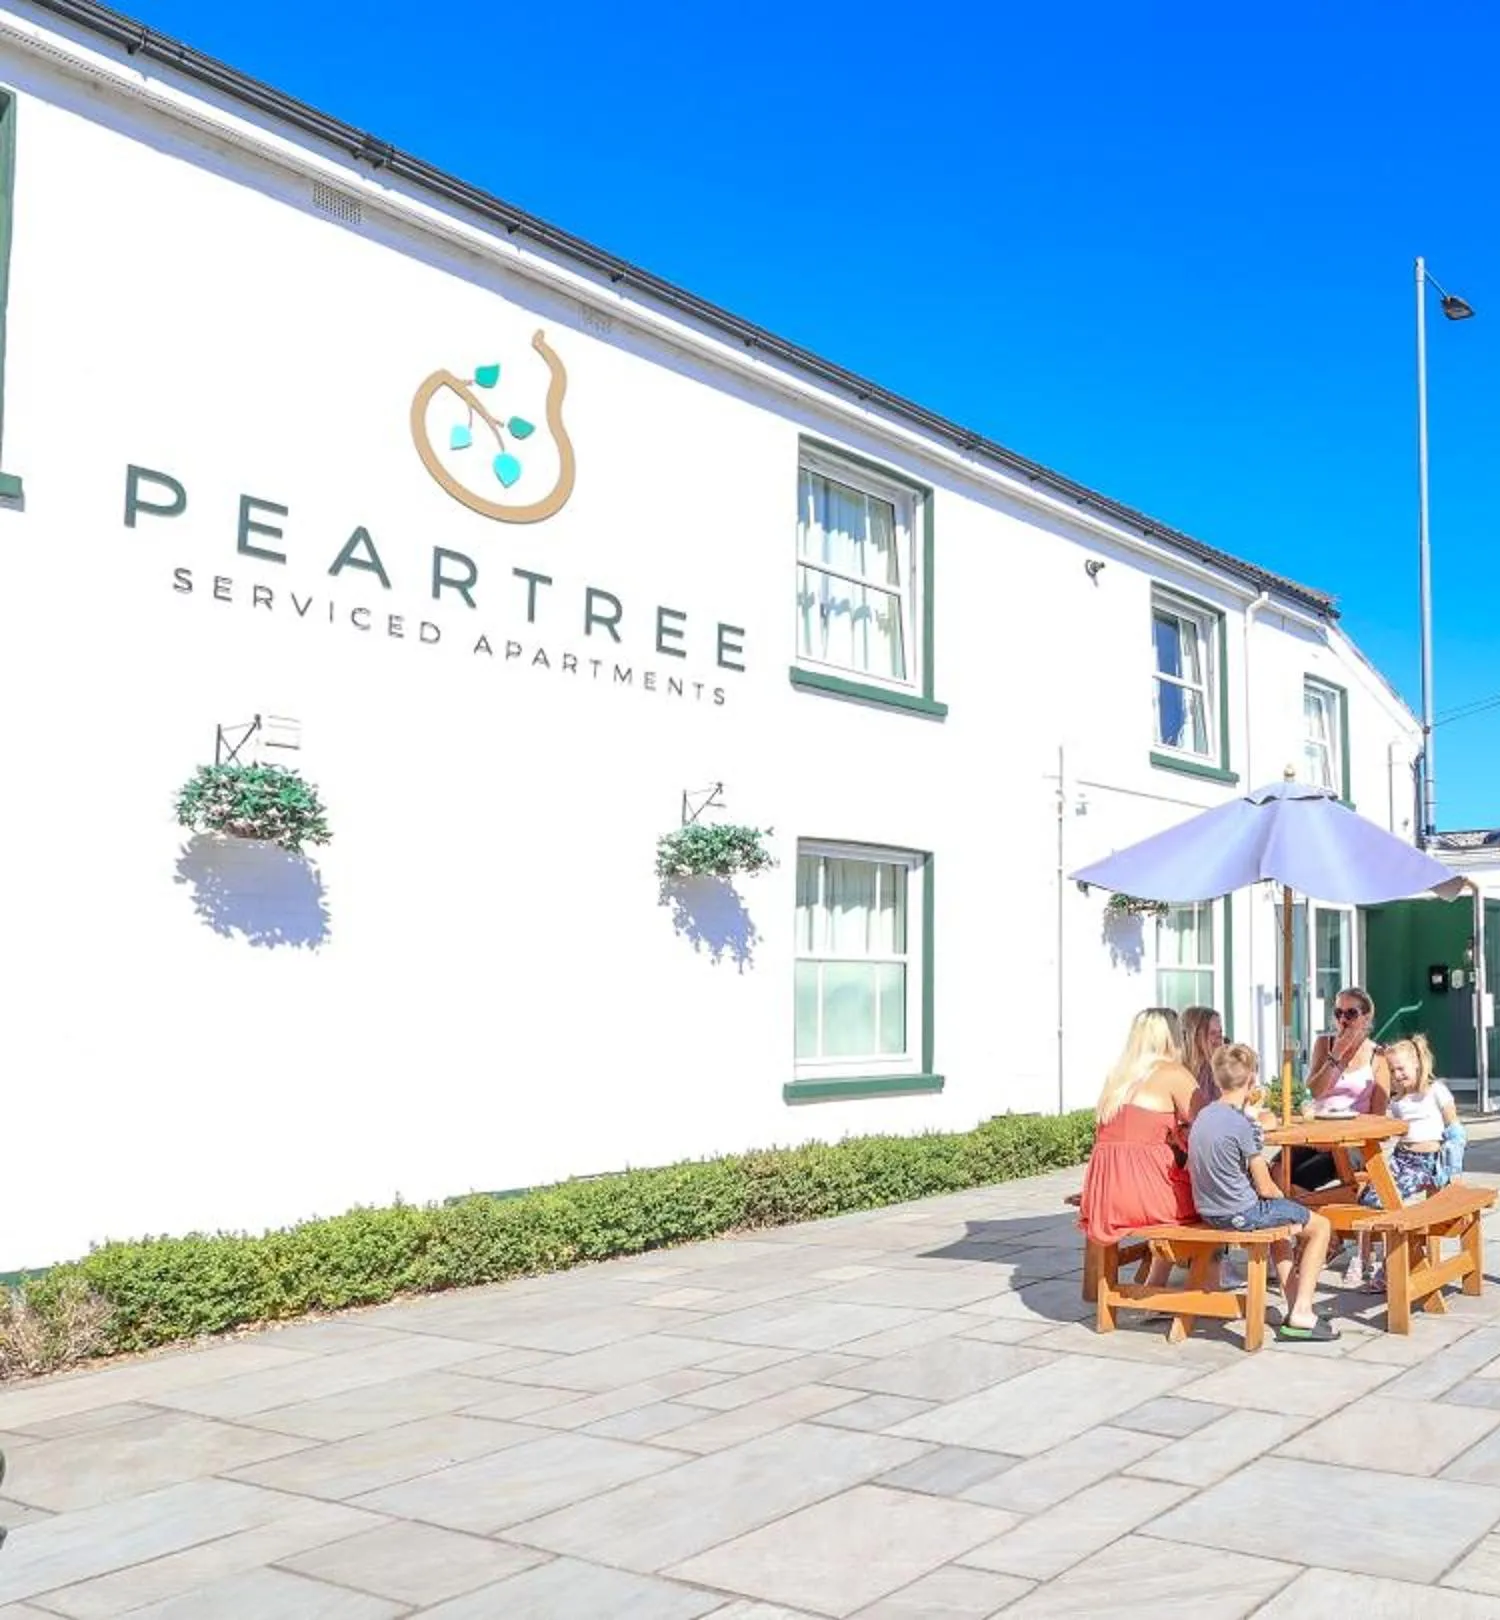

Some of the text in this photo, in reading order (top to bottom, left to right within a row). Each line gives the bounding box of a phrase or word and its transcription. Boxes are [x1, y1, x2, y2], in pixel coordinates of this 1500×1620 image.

[123, 463, 747, 674] PEARTREE
[172, 567, 726, 706] SERVICED APARTMENTS
